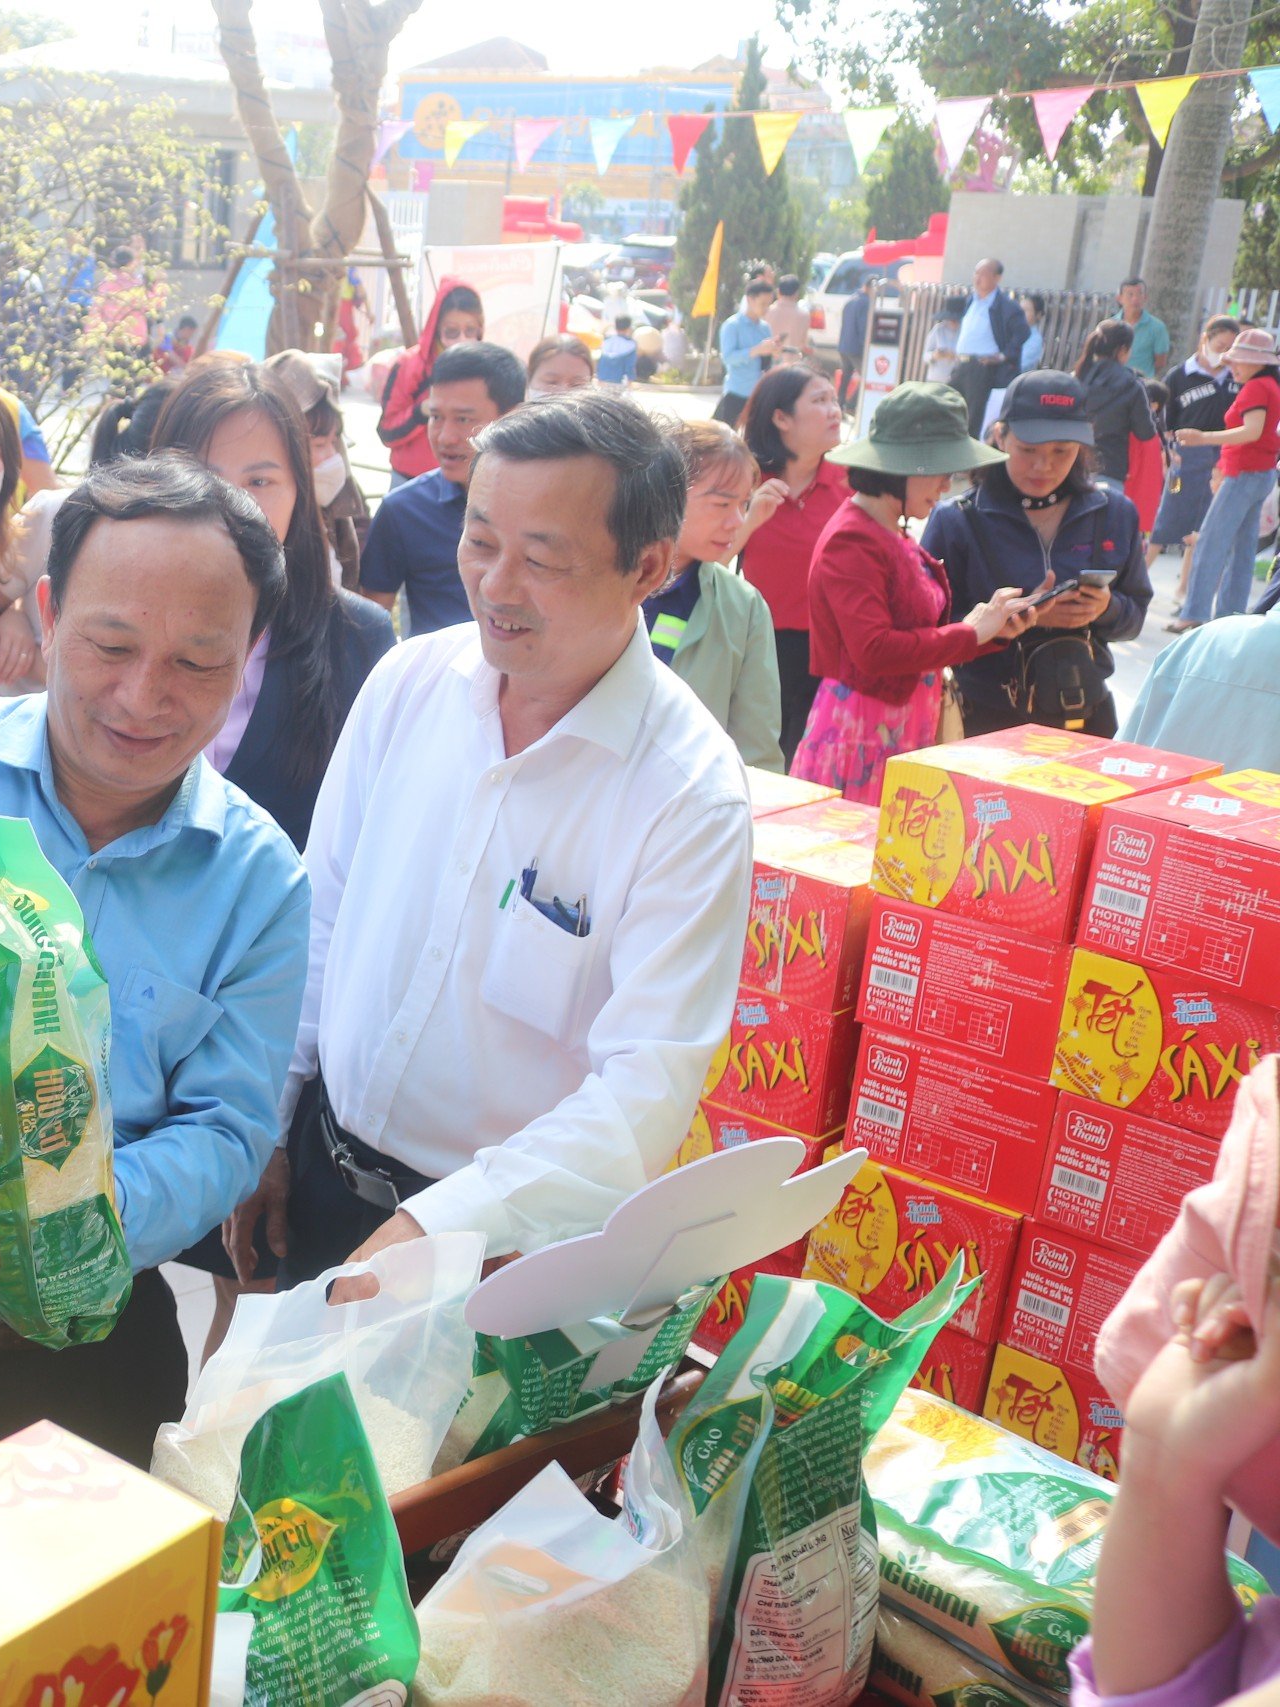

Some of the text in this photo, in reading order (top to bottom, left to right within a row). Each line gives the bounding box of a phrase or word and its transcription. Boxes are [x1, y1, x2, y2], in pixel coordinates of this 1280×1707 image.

[1179, 383, 1216, 410] SPRING
[1095, 908, 1143, 929] HOTLINE
[872, 988, 915, 1006] HOTLINE
[1083, 979, 1144, 1058] Tết
[860, 1119, 901, 1137] HOTLINE
[1053, 1188, 1102, 1211] HOTLINE
[1020, 1311, 1066, 1336] HOTLINE
[333, 1574, 364, 1591] TCVN
